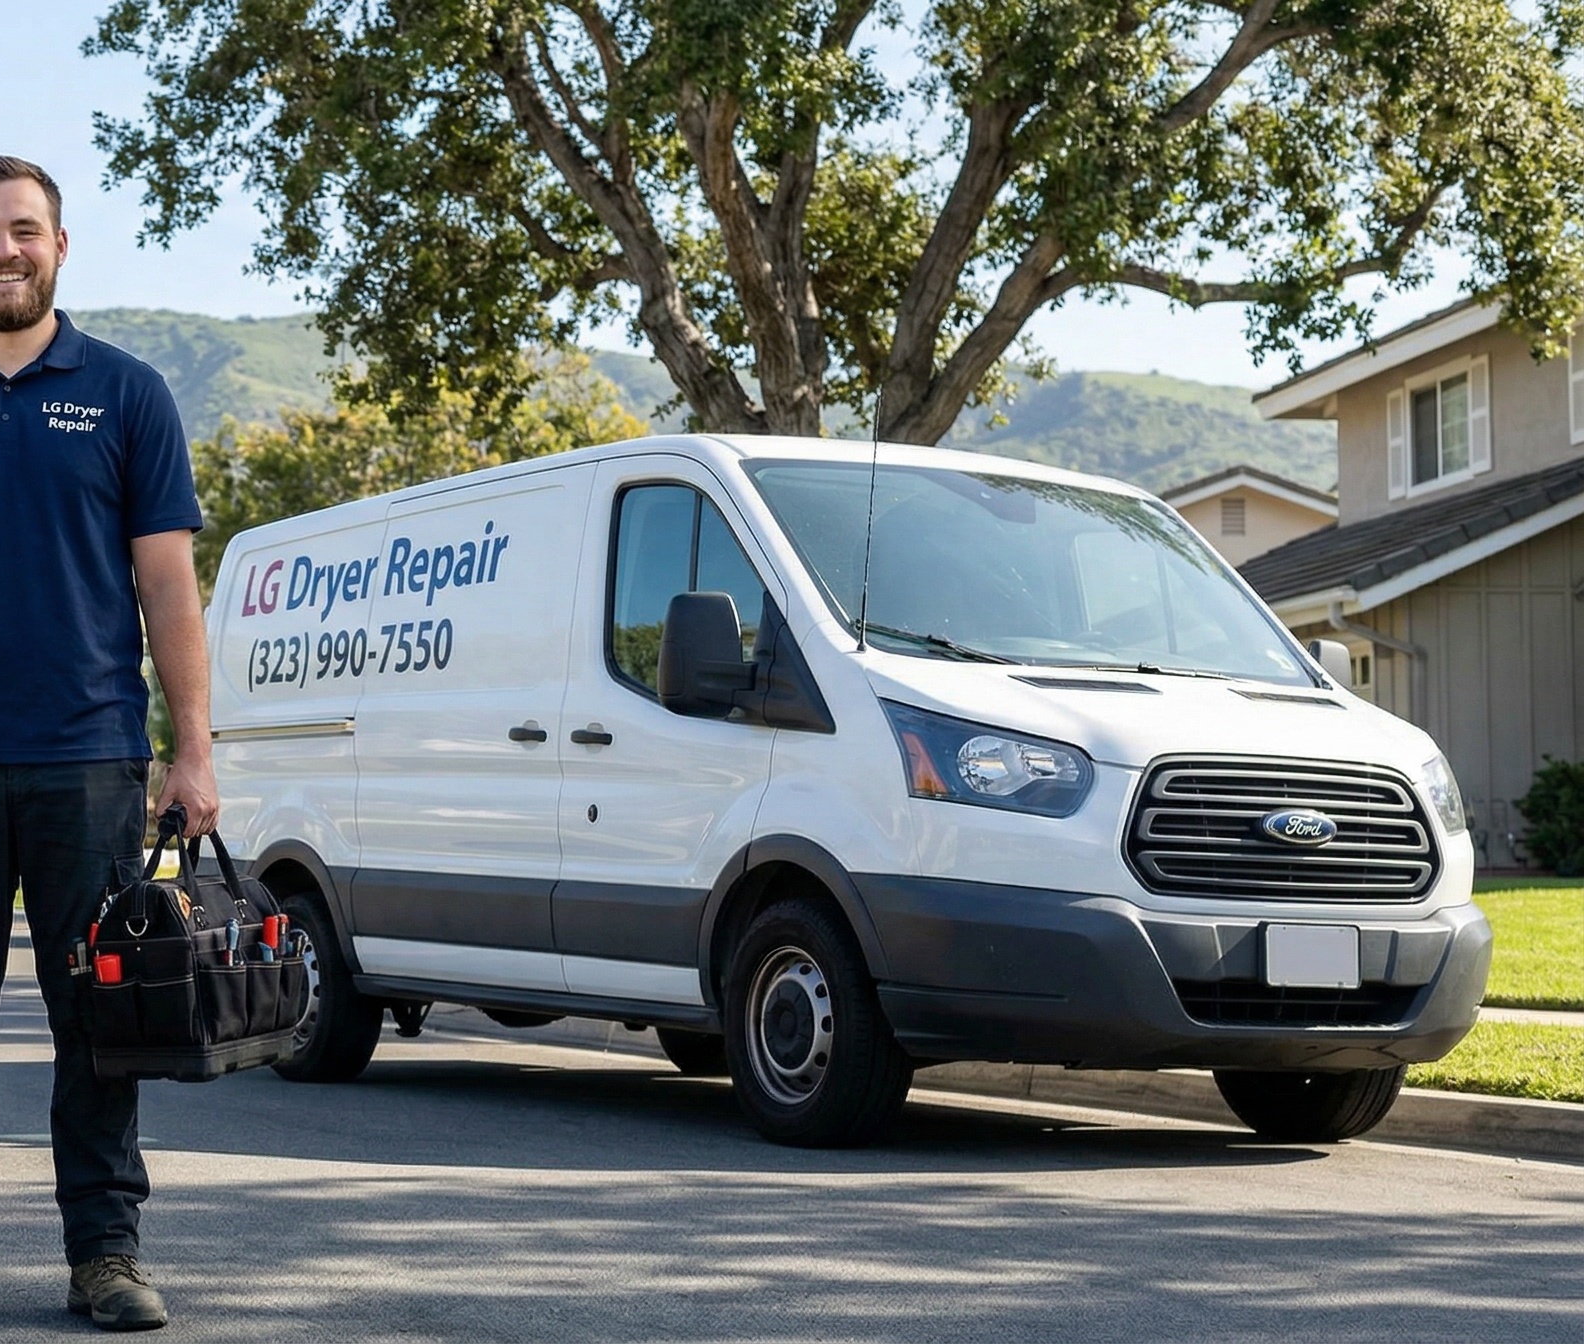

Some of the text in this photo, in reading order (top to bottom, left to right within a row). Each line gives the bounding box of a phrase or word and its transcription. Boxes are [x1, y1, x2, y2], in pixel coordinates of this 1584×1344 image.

[42, 402, 105, 419] LG Dryer
[48, 417, 96, 433] Repair
[241, 520, 509, 622] LG Dryer Repair
[248, 618, 453, 692] (323) 990-7550
[1285, 815, 1322, 836] Ford
